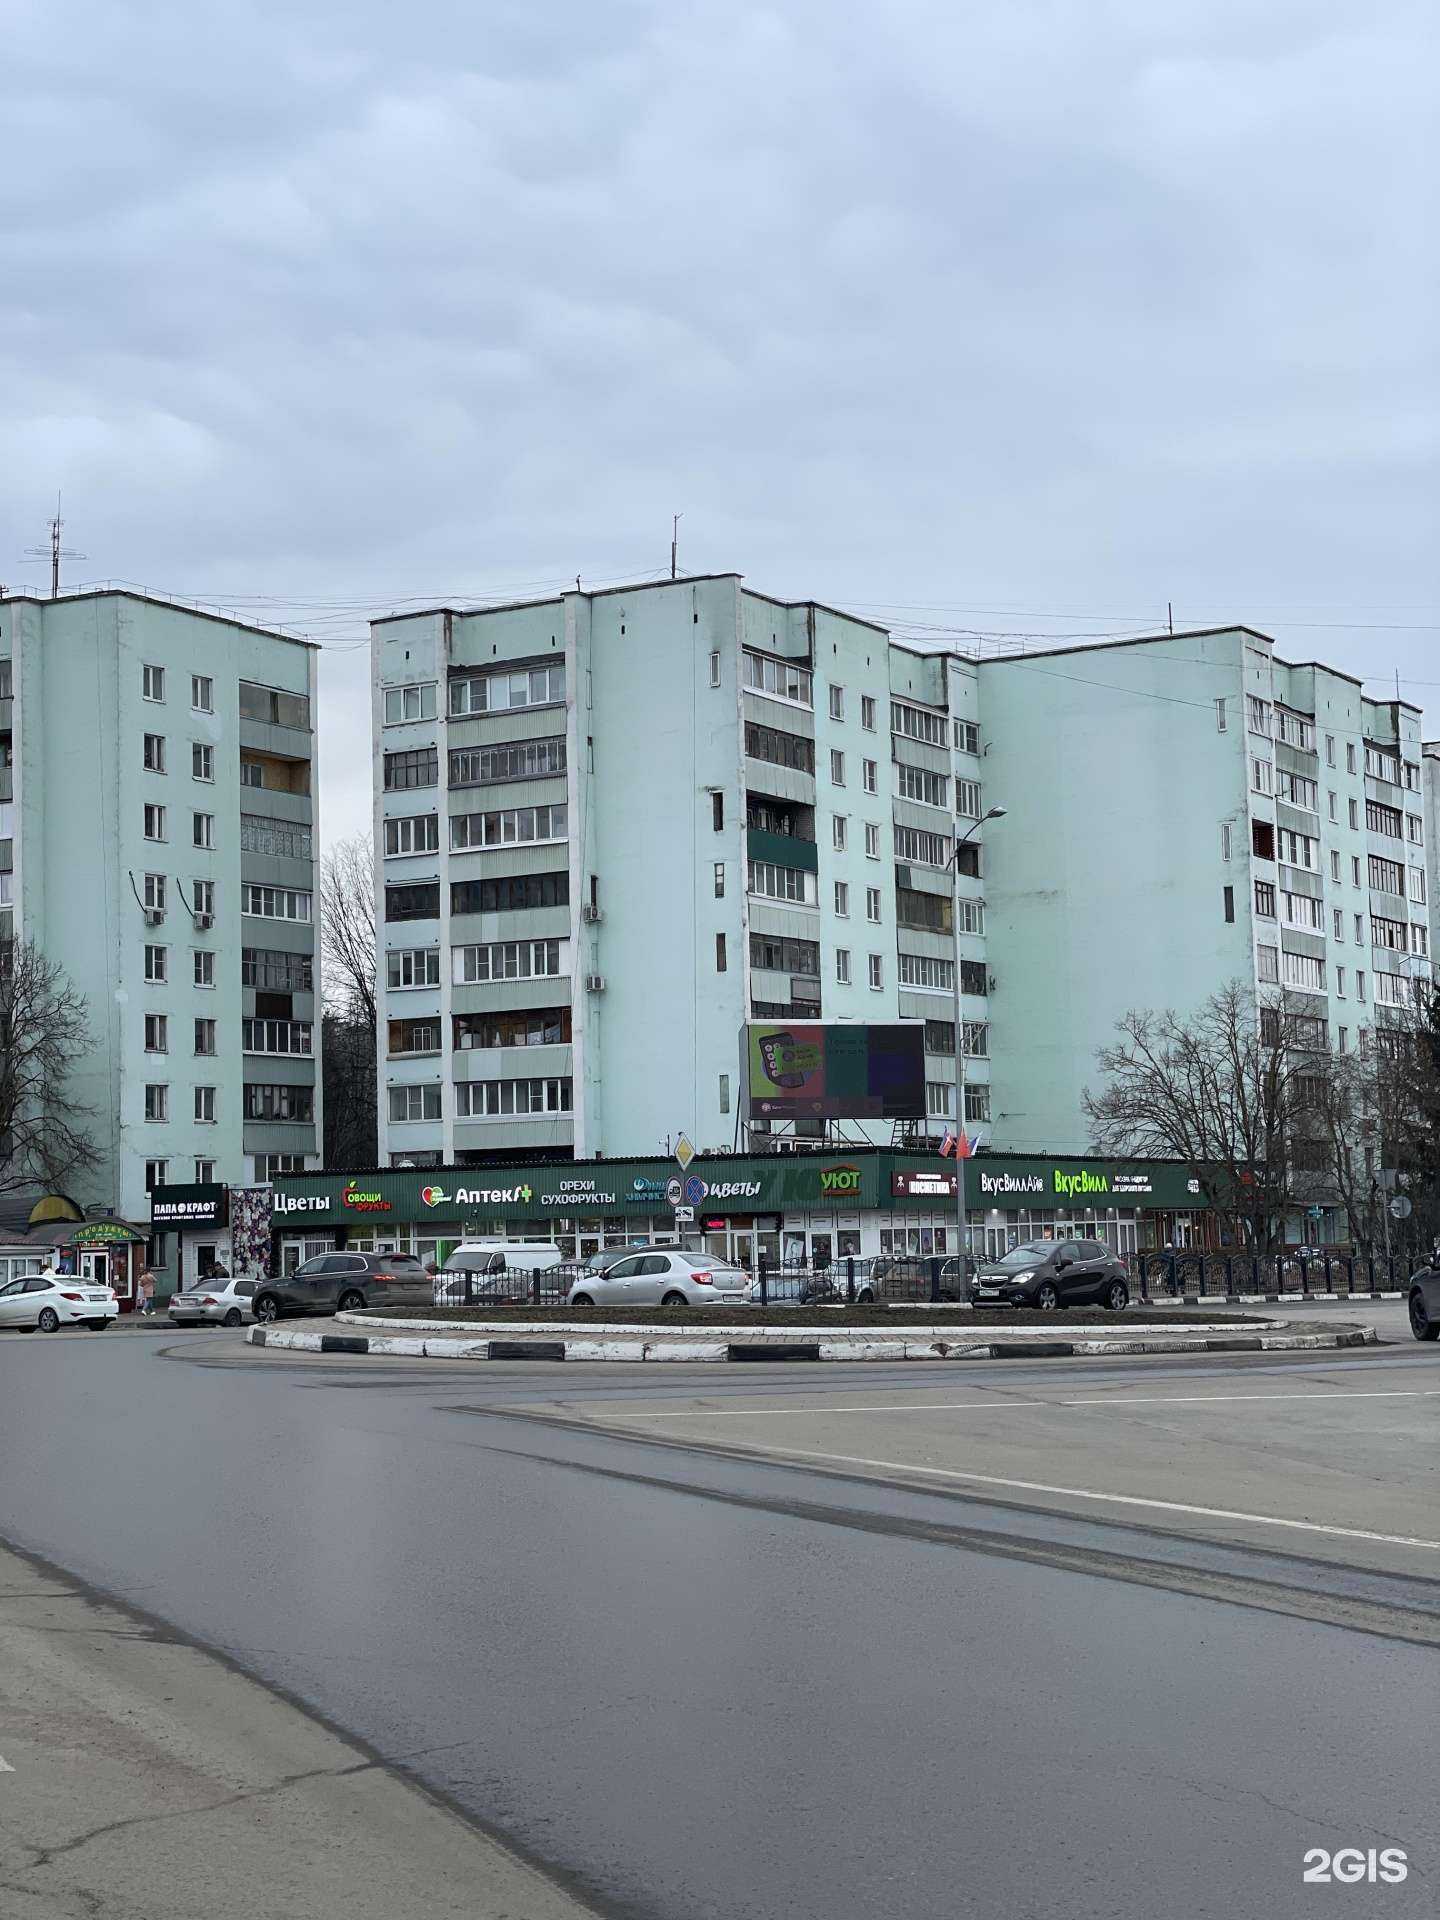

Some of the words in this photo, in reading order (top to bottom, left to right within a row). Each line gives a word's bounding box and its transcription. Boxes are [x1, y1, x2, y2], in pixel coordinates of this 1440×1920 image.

[560, 1180, 596, 1191] ОРЕХИ
[821, 1172, 862, 1189] УЮТ
[1054, 1170, 1109, 1198] ВкусВилл
[274, 1194, 330, 1215] Цветы
[541, 1193, 616, 1205] СУХОФРУКТЫ
[154, 1203, 177, 1214] ПАПА
[187, 1202, 216, 1213] КРАФТ
